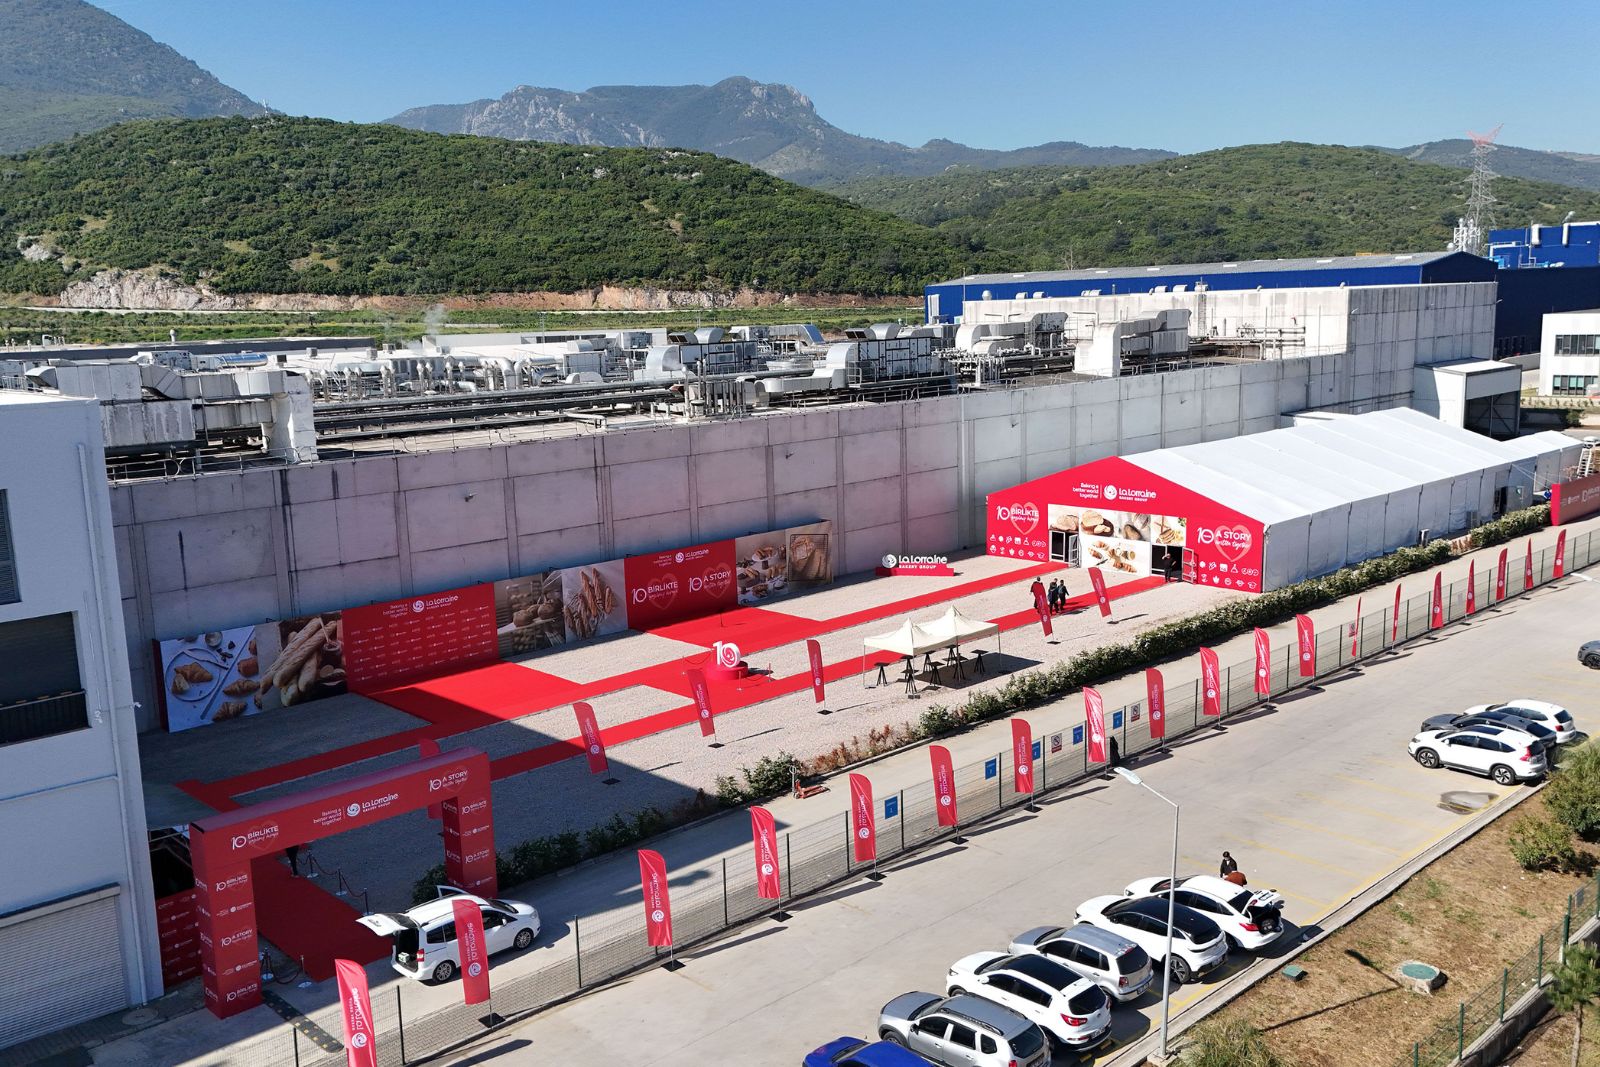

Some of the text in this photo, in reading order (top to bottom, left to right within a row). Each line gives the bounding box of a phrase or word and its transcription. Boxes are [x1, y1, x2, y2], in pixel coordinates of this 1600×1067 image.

[1128, 489, 1156, 498] Lorraine
[996, 506, 1010, 520] 10
[1197, 527, 1214, 544] 10
[1224, 532, 1251, 540] STORY
[899, 555, 947, 564] La Lorraine
[688, 577, 702, 592] 10
[710, 570, 731, 581] STORY
[434, 595, 458, 604] Lorraine
[632, 588, 647, 604] 10
[712, 640, 740, 668] 10
[430, 779, 442, 792] 10
[448, 770, 467, 780] STORY
[371, 793, 399, 806] Lorraine
[231, 836, 246, 850] 10
